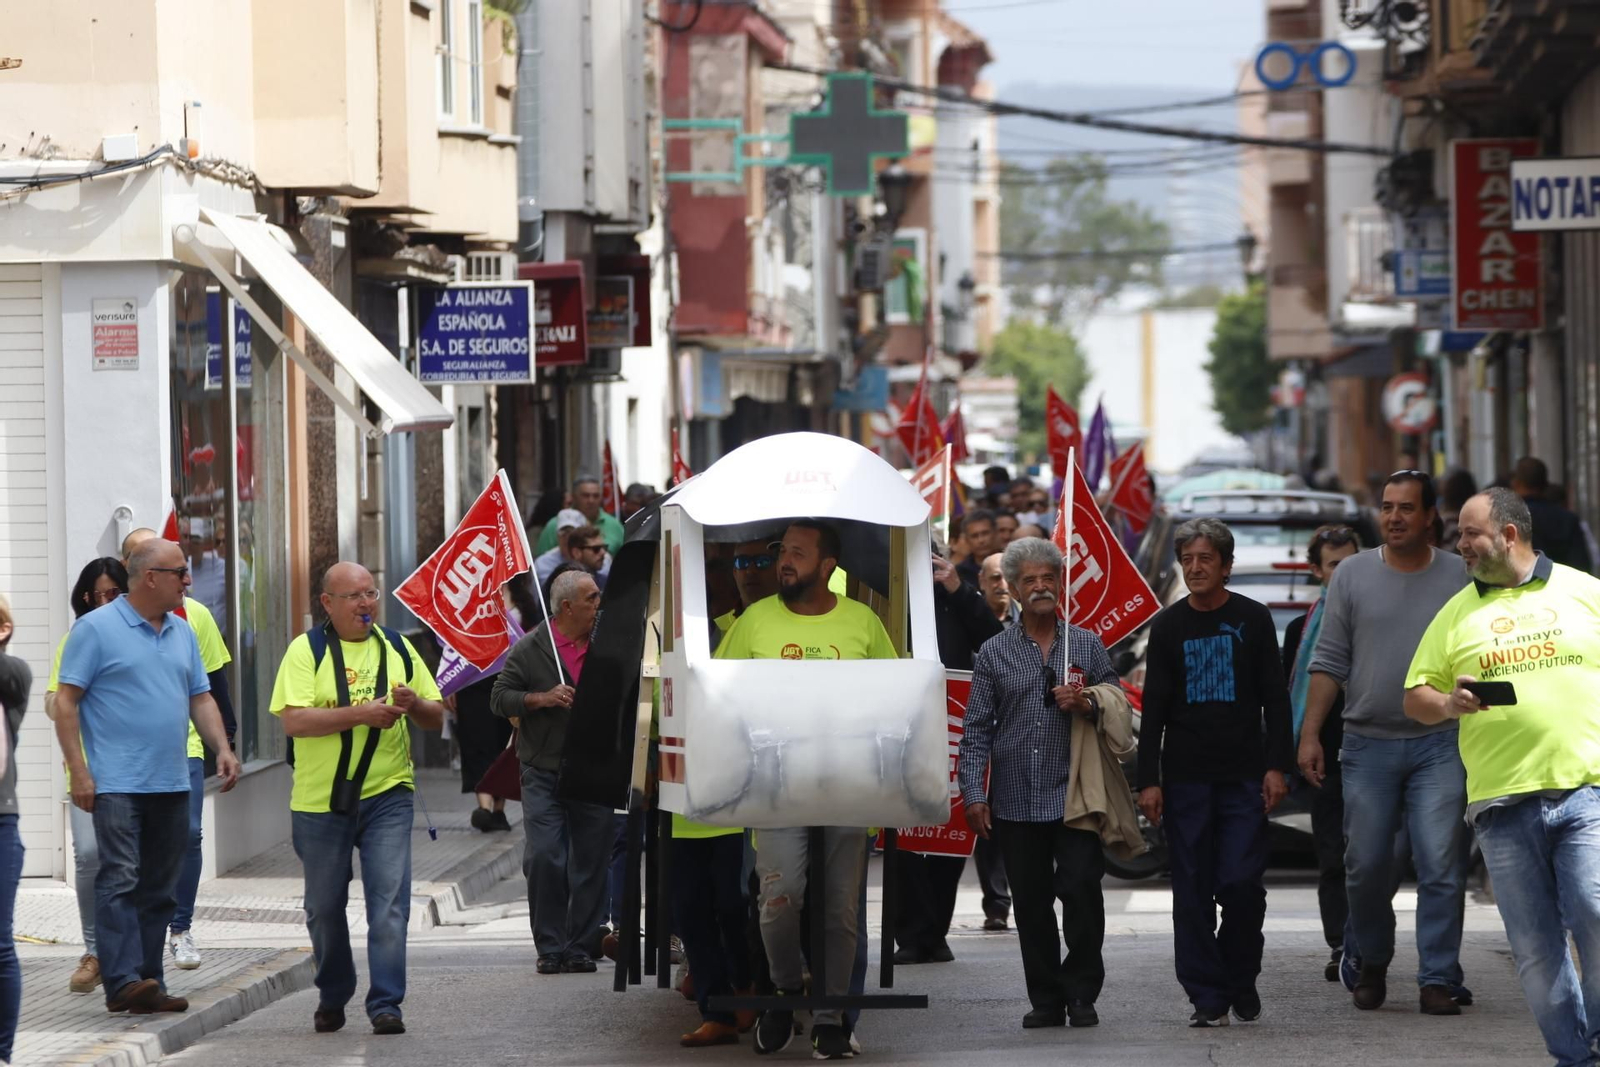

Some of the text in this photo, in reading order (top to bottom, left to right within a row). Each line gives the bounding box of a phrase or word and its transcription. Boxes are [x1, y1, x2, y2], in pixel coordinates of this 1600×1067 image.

[1478, 148, 1516, 282] BAZAR
[436, 289, 513, 307] LA ALIANZA
[1462, 290, 1534, 310] CHEN
[94, 313, 136, 321] verisure
[438, 311, 506, 331] ESPAÑOLA
[421, 339, 445, 356] S.A.
[448, 338, 466, 355] DE
[469, 337, 528, 356] SEGUROS
[442, 360, 507, 371] SEGURALIANZA
[478, 371, 488, 381] DE
[490, 370, 529, 381] SEGUROS
[438, 533, 497, 611] UGT
[1517, 628, 1563, 643] mayo
[805, 646, 821, 654] FICA
[1479, 641, 1556, 670] UNIDOS
[1481, 655, 1583, 680] HACIENDO FUTURO
